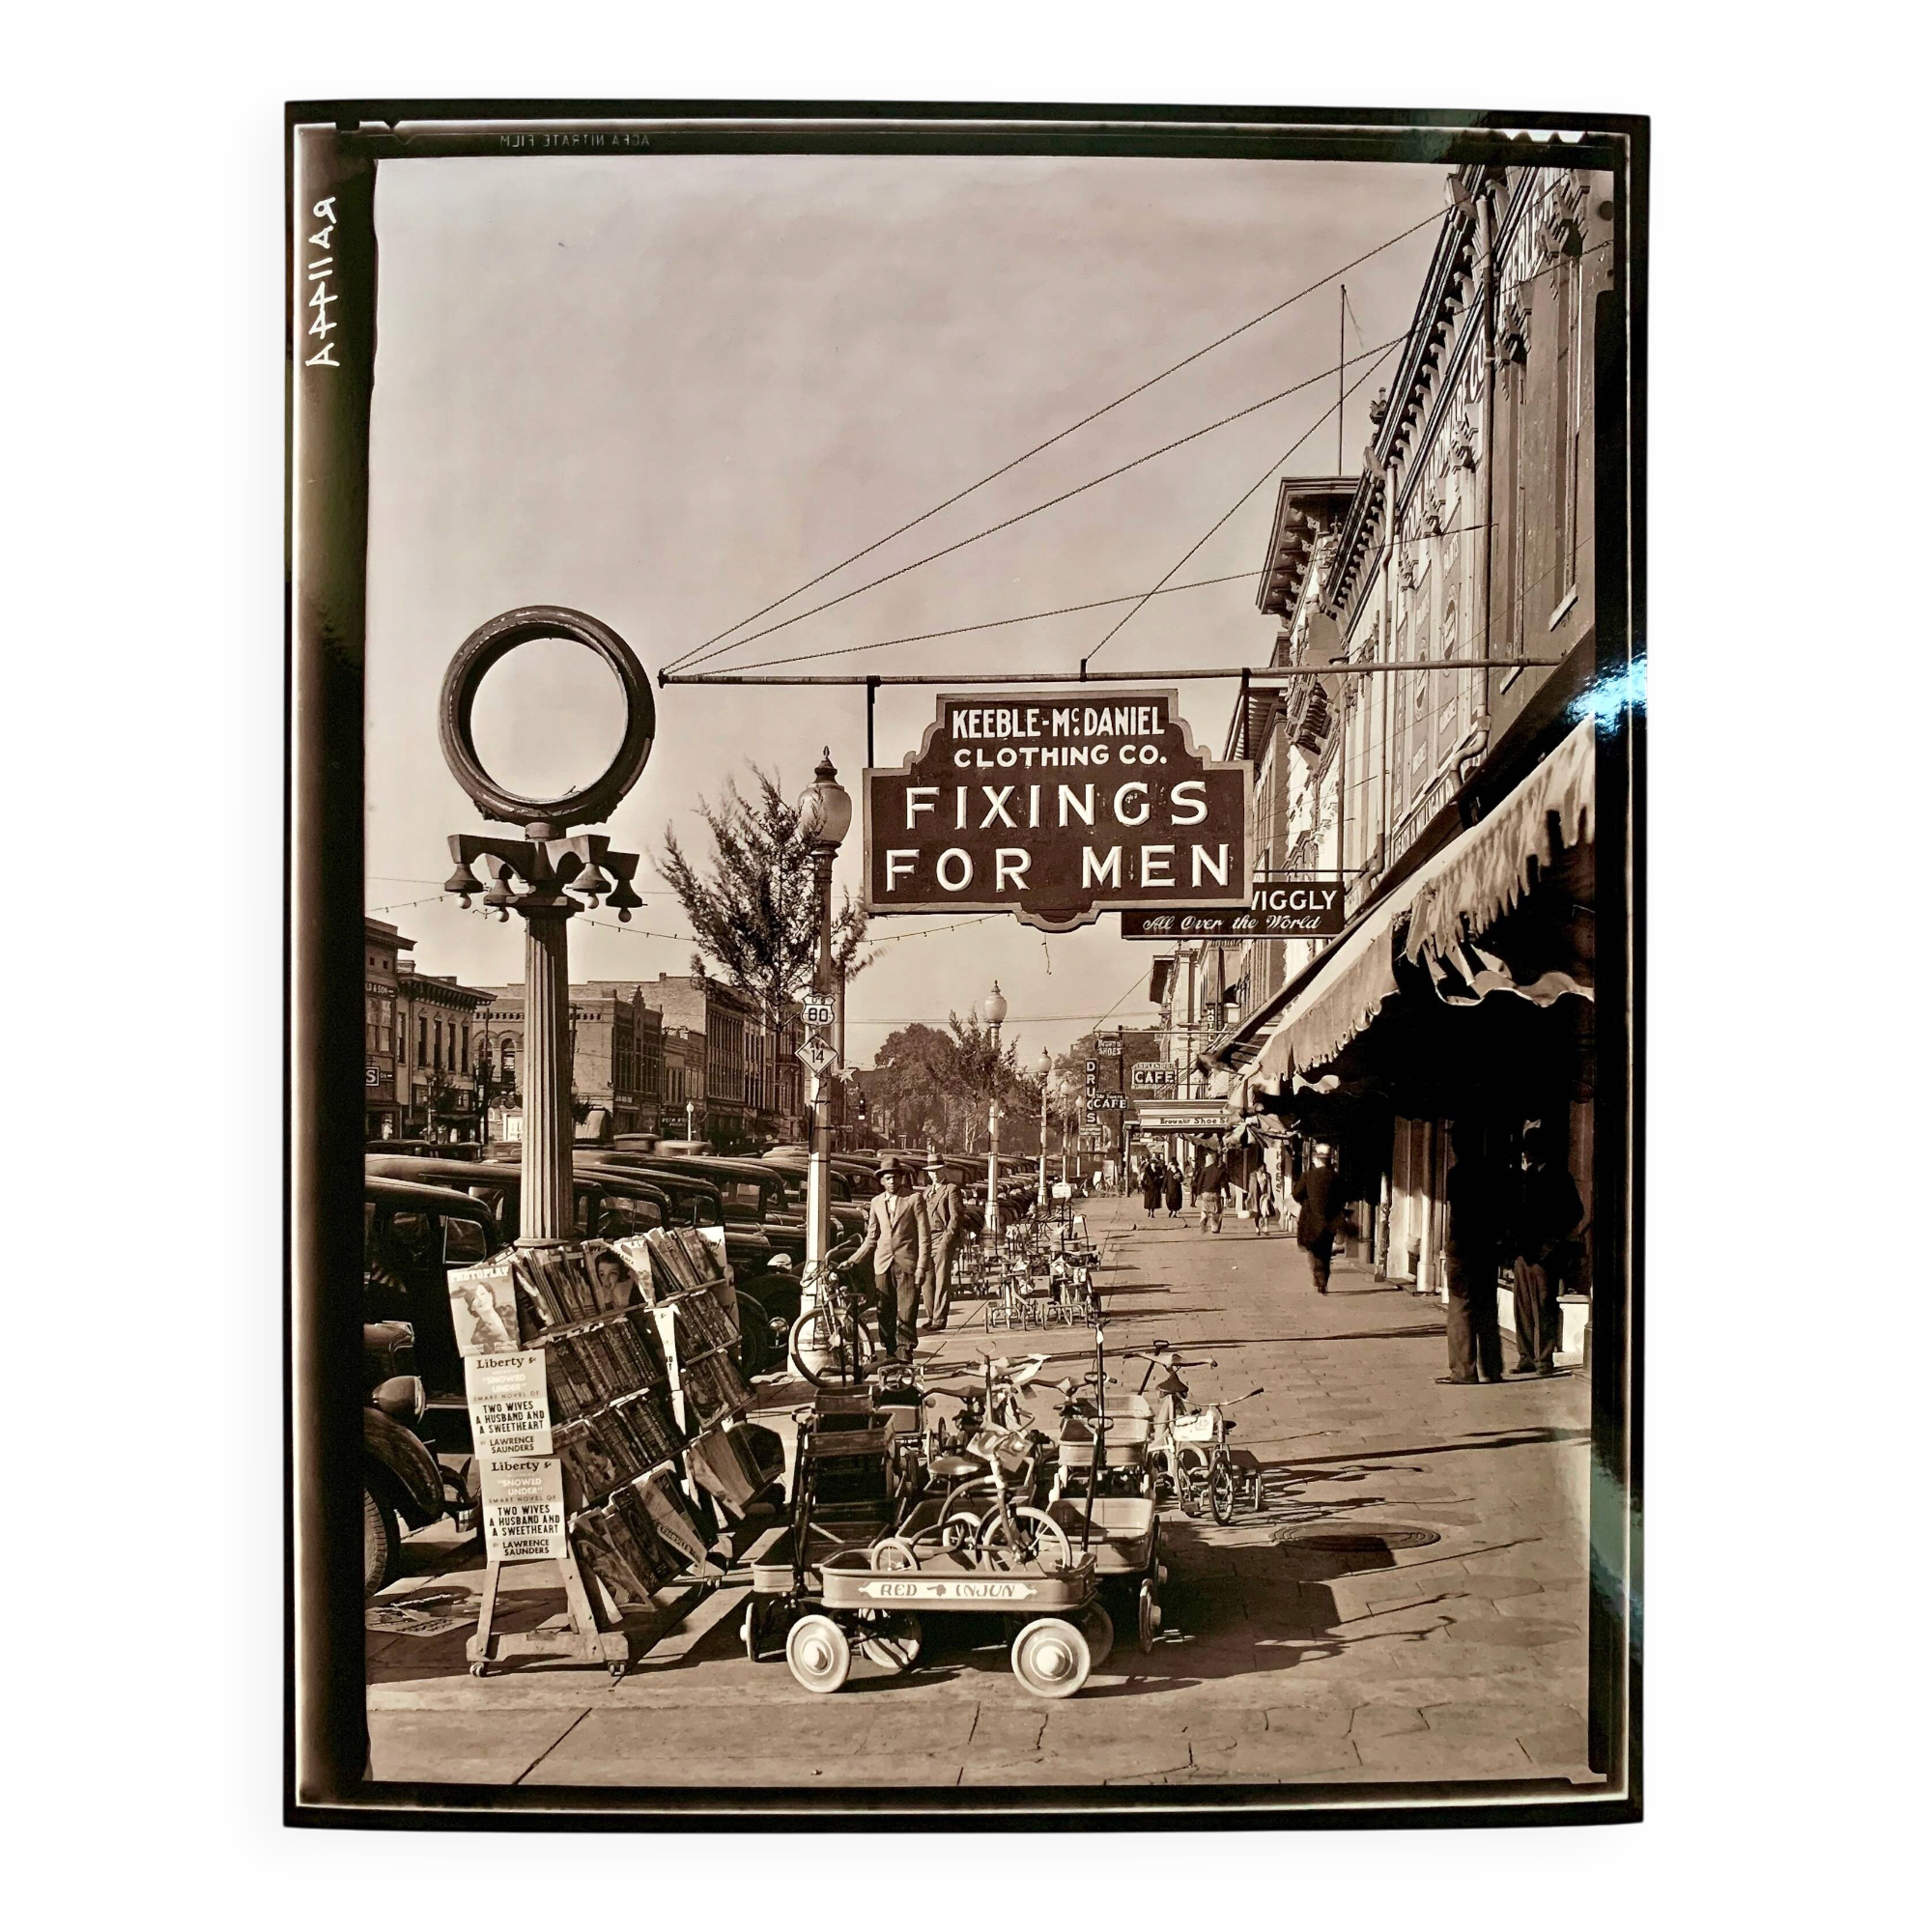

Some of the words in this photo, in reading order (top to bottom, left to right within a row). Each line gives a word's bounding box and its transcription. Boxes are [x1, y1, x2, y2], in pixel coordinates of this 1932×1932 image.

[953, 744, 1110, 768] CLOTHING
[1119, 744, 1168, 765] CO.
[905, 781, 1210, 831] FIXINGS
[885, 847, 1032, 893] FOR
[1081, 844, 1231, 890] MEN
[1142, 915, 1176, 930] All
[1180, 915, 1224, 930] Over
[1233, 914, 1260, 930] the
[1266, 914, 1321, 929] World
[809, 1008, 829, 1022] 80
[811, 1049, 825, 1064] 14
[1098, 1047, 1122, 1057] SHOES
[1134, 1070, 1175, 1084] CAFE
[1093, 1098, 1127, 1109] CAFE
[450, 1266, 510, 1283] PHOTOPLAY
[476, 1357, 525, 1370] Liberty
[483, 1404, 502, 1413] TWO
[505, 1401, 534, 1411] WIVES
[476, 1415, 482, 1425] A
[484, 1412, 524, 1424] HUSBAND
[526, 1410, 545, 1420] AND
[479, 1425, 485, 1435] A
[488, 1420, 544, 1434] SWEETHEART
[489, 1435, 535, 1446] LAWRENCE
[491, 1443, 535, 1454] SAUNDERS
[491, 1461, 540, 1472] Liberty
[497, 1506, 518, 1517] TWO
[522, 1504, 551, 1515] WIVES
[489, 1518, 496, 1527] A
[498, 1516, 539, 1527] HUSBAND
[542, 1515, 560, 1523] AND
[492, 1527, 498, 1537] A
[501, 1524, 558, 1536] SWEETHEART
[502, 1539, 550, 1549] LAWRENCE
[504, 1547, 550, 1556] SAUNDERS
[880, 1583, 917, 1596] RED
[954, 1584, 1014, 1597] INJUN
